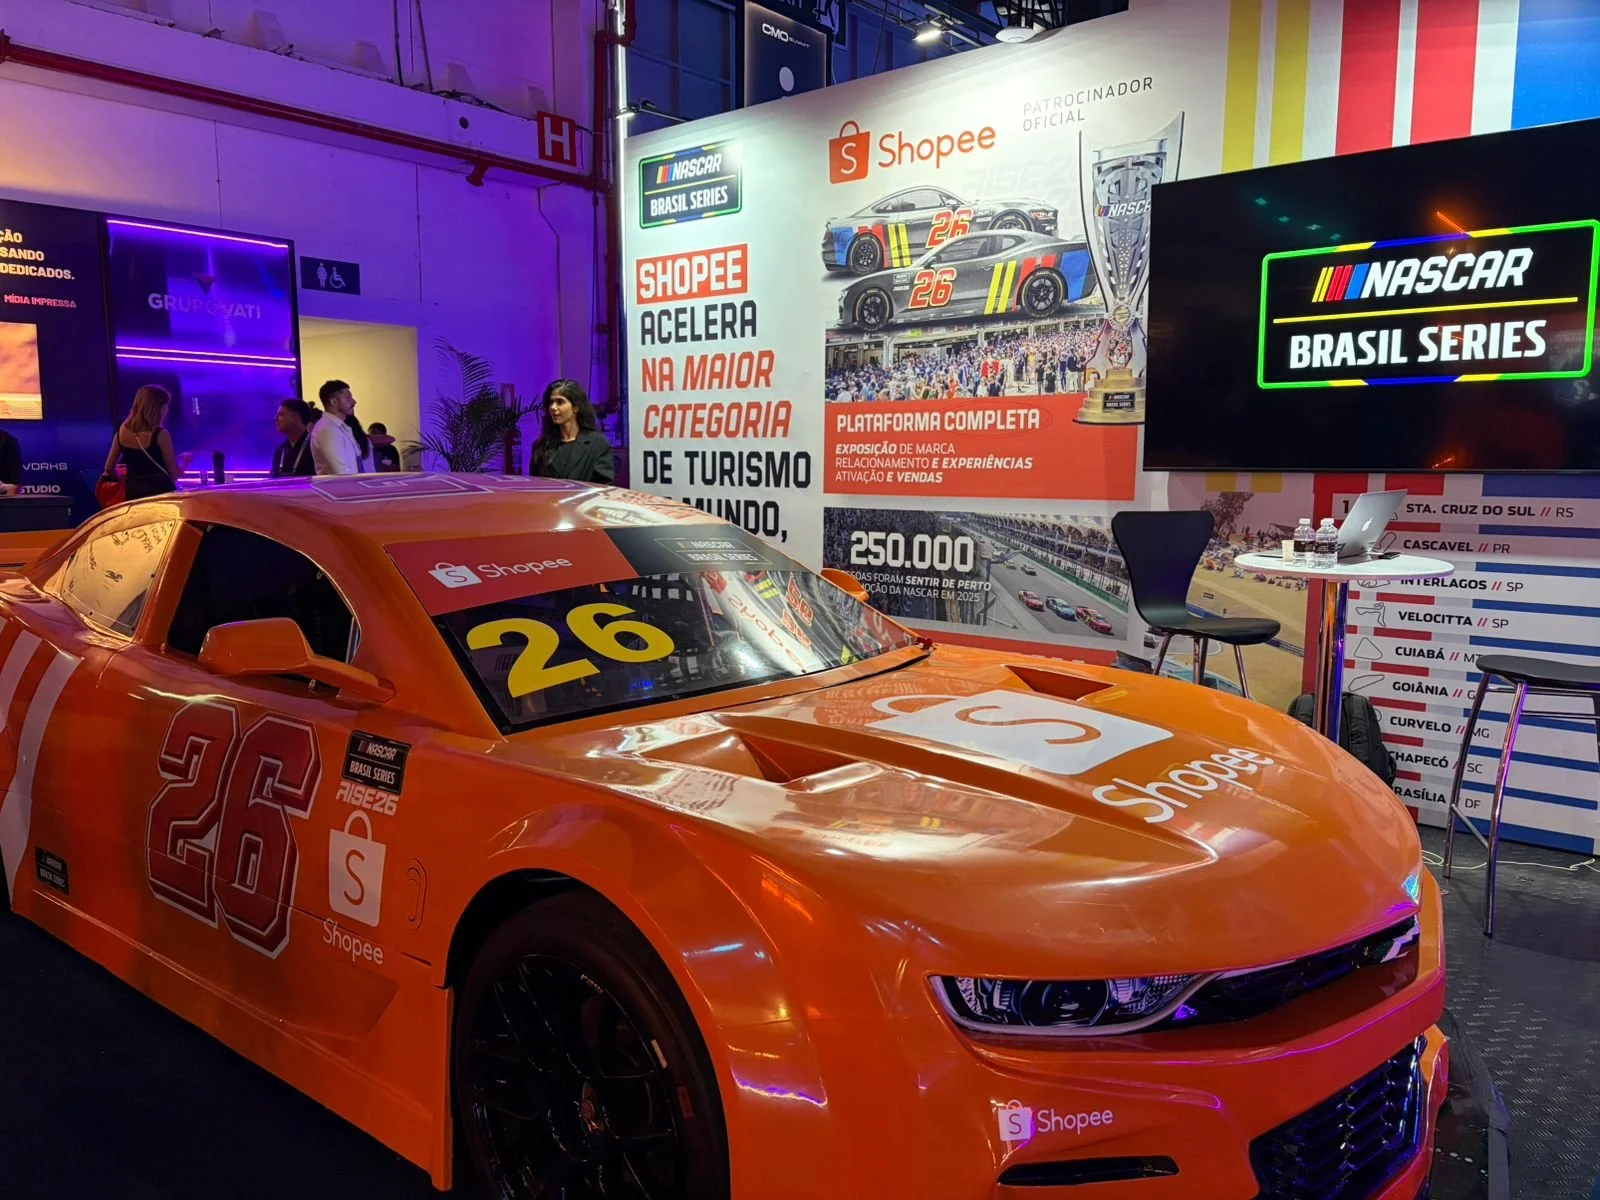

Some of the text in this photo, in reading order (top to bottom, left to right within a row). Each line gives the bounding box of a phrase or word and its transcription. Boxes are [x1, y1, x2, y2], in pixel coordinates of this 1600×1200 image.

[762, 23, 789, 43] CMO
[1023, 76, 1154, 116] PATROCINADOR
[1022, 108, 1086, 132] OFICIAL
[543, 115, 571, 161] H
[878, 126, 997, 169] Shopee
[671, 153, 723, 182] NASCAR
[650, 184, 729, 217] BRASIL SERIES
[1106, 198, 1151, 217] NASCA
[925, 207, 974, 249] 26
[0, 262, 76, 280] DEDICADOS.
[639, 249, 743, 299] SHOPEE
[1359, 247, 1534, 300] NASCAR
[4, 293, 77, 309] MÍDIA IMPRESSA
[907, 267, 958, 310] 26
[641, 299, 757, 346] ACELERA
[1289, 319, 1547, 370] BRASIL SERIES
[642, 350, 775, 393] NA MAIOR
[643, 400, 792, 439] CATEGORIA
[836, 408, 1041, 433] PLATAFORMA COMPLETA
[835, 440, 955, 457] EXPOSIÇÃO DE MARCA
[643, 450, 812, 489] DE TURISMO
[835, 454, 1033, 469] RELACIONAMENTO E EXPERIÊNCIAS
[835, 469, 943, 484] ATIVAÇÃO E VENDAS
[1405, 503, 1436, 514] STA.
[1441, 503, 1478, 515] CRUZ
[1482, 504, 1503, 516] DO
[1507, 505, 1536, 517] SUL
[1555, 507, 1574, 518] RS
[850, 531, 975, 573] 250.000
[1403, 539, 1474, 552] CASCAVEL
[1493, 543, 1511, 554] PR
[477, 558, 573, 578] Shopee
[874, 573, 904, 584] FORAM
[905, 575, 940, 587] SENTIR
[942, 578, 956, 589] DE
[957, 579, 992, 591] PERTO
[889, 585, 902, 595] DA
[903, 587, 939, 599] NASCAR
[941, 589, 955, 600] EM
[957, 591, 980, 602] 2025
[1506, 581, 1524, 592] SP
[1398, 611, 1473, 626] VELOCITTA
[1492, 618, 1509, 629] SP
[466, 603, 675, 698] 26
[1395, 646, 1445, 660] CUIABÁ
[1392, 681, 1449, 697] GOIÂNIA
[1467, 690, 1476, 700] G
[1390, 716, 1452, 733] CURVELO
[366, 742, 397, 761] NASCAR
[349, 760, 396, 784] BRASIL SERIES
[1466, 762, 1484, 774] SC
[1092, 746, 1275, 824] Shopee
[1392, 784, 1481, 809] RASÍLIA DF
[146, 698, 323, 960] 26
[322, 917, 384, 965] Shopee
[1037, 1108, 1114, 1136] Shopee
